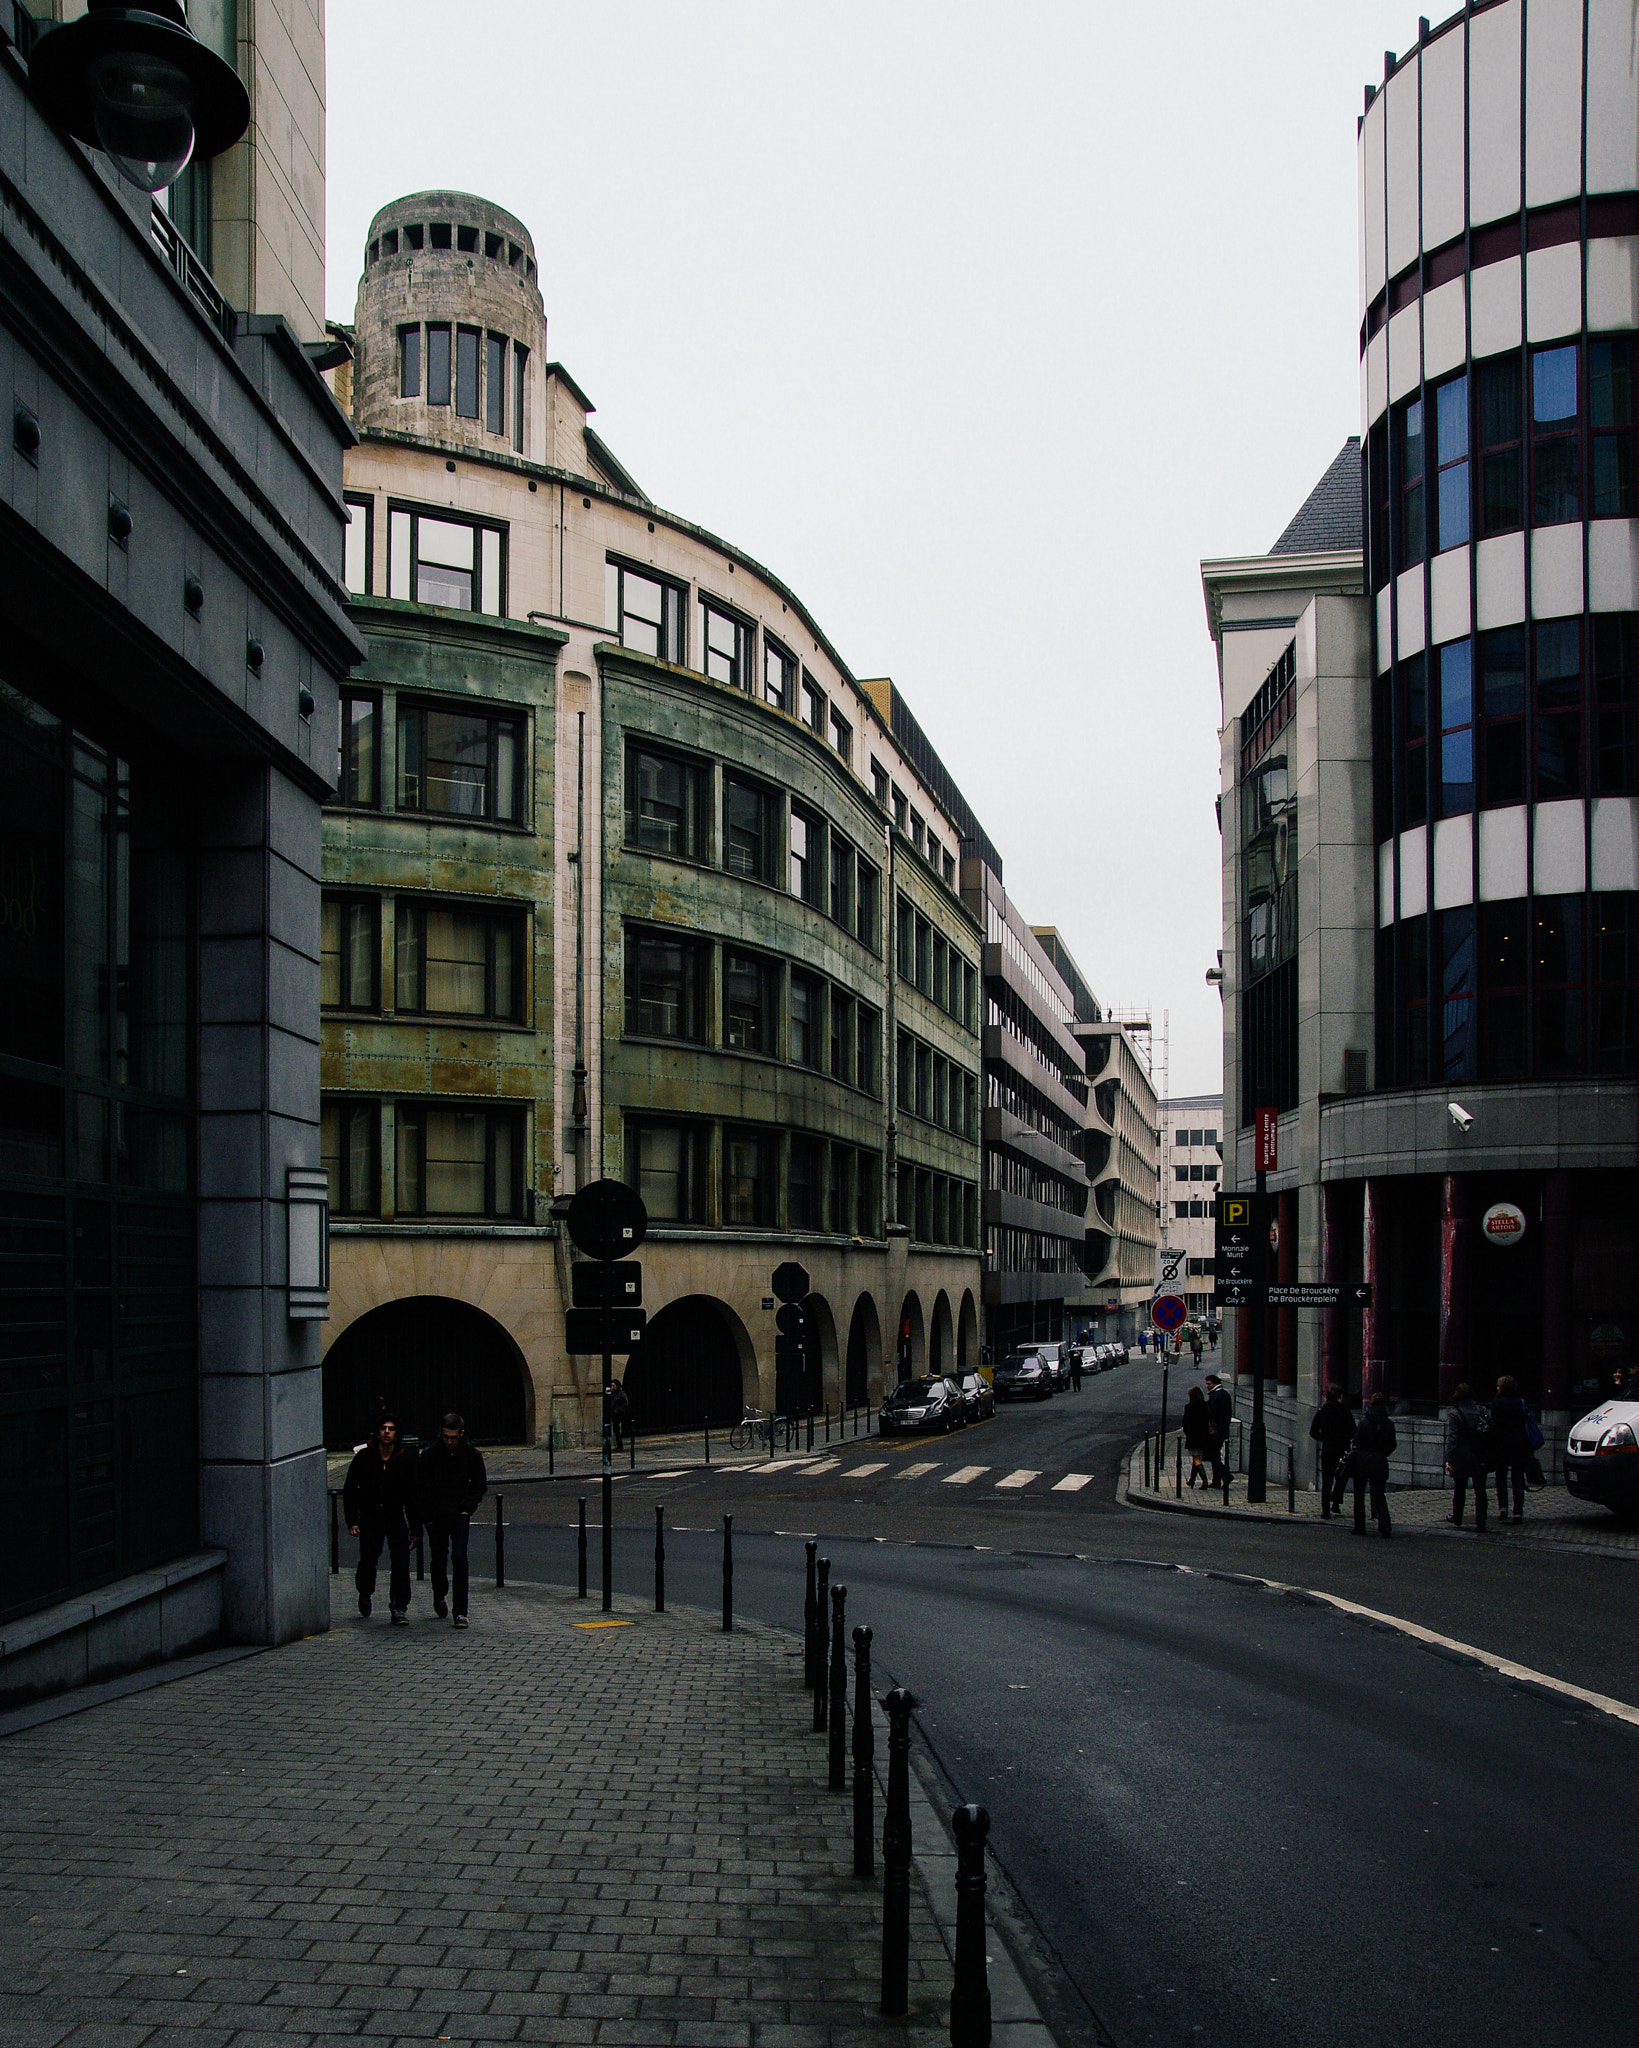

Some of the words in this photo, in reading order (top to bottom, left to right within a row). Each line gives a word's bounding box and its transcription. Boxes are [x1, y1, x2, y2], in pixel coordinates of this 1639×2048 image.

[1229, 1203, 1243, 1222] P
[1268, 1286, 1288, 1294] Place
[1301, 1286, 1340, 1294] Brouckère
[1280, 1295, 1337, 1303] Brouckèreplein
